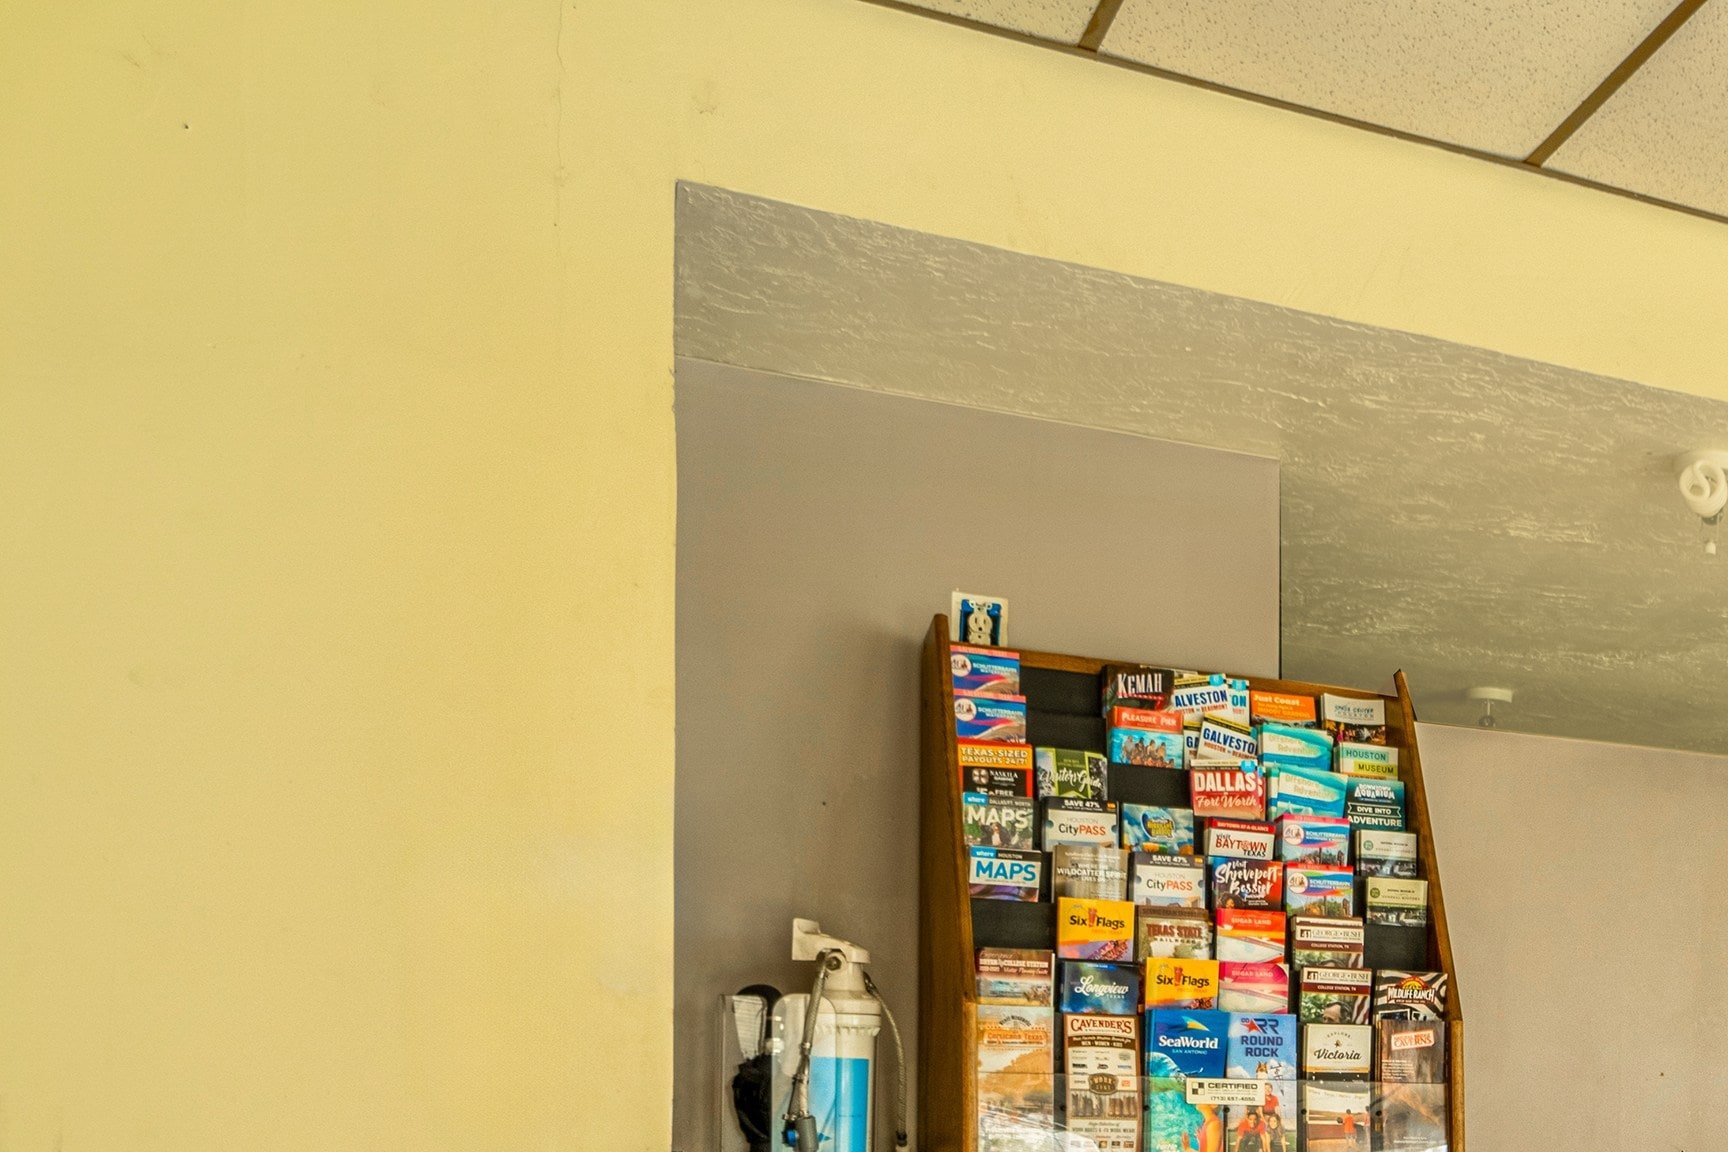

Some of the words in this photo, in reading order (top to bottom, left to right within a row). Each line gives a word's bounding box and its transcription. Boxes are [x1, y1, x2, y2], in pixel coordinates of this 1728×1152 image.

[1117, 673, 1163, 698] KEMAH
[1175, 690, 1228, 708] ALVESTON
[1122, 712, 1158, 724] PLEASURE
[1203, 728, 1258, 754] GALVESTO
[962, 755, 1003, 763] PAYOUTS
[1346, 750, 1386, 761] HOUSTON
[1358, 763, 1394, 774] MUSEUM
[1194, 772, 1256, 792] DALLAS
[1354, 786, 1396, 800] AQUARIUM
[1064, 799, 1083, 807] SAVE
[1196, 795, 1221, 807] Fort
[1222, 795, 1257, 808] Worth
[1357, 806, 1373, 814] DIVE
[1375, 807, 1391, 815] INTO
[967, 806, 1028, 829] MAPS
[1348, 815, 1402, 827] ADVENTURE
[1058, 823, 1106, 836] CityPASS
[1216, 837, 1268, 851] BAYTOWN
[1152, 854, 1172, 862] SAVE
[1243, 849, 1266, 857] TEXAS
[976, 860, 1036, 881] MAPS
[1146, 879, 1193, 891] CityPASS
[1229, 881, 1274, 895] Bossier
[1070, 915, 1087, 925] Six
[1096, 916, 1125, 930] Flags
[1146, 924, 1175, 937] TEXAS
[1177, 925, 1202, 939] STATE
[1074, 975, 1129, 996] Longview
[1157, 974, 1173, 985] Six
[1182, 976, 1210, 989] Flags
[1387, 987, 1413, 1000] WILDLIFE
[1413, 988, 1435, 1002] RANCH
[1071, 1018, 1133, 1034] CAVENDER'S
[1158, 1036, 1219, 1049] SeaWorld
[1241, 1035, 1283, 1046] ROUND
[1245, 1047, 1279, 1057] ROCK
[1313, 1049, 1362, 1061] Victoria
[1207, 1082, 1258, 1090] CERTIFIED
